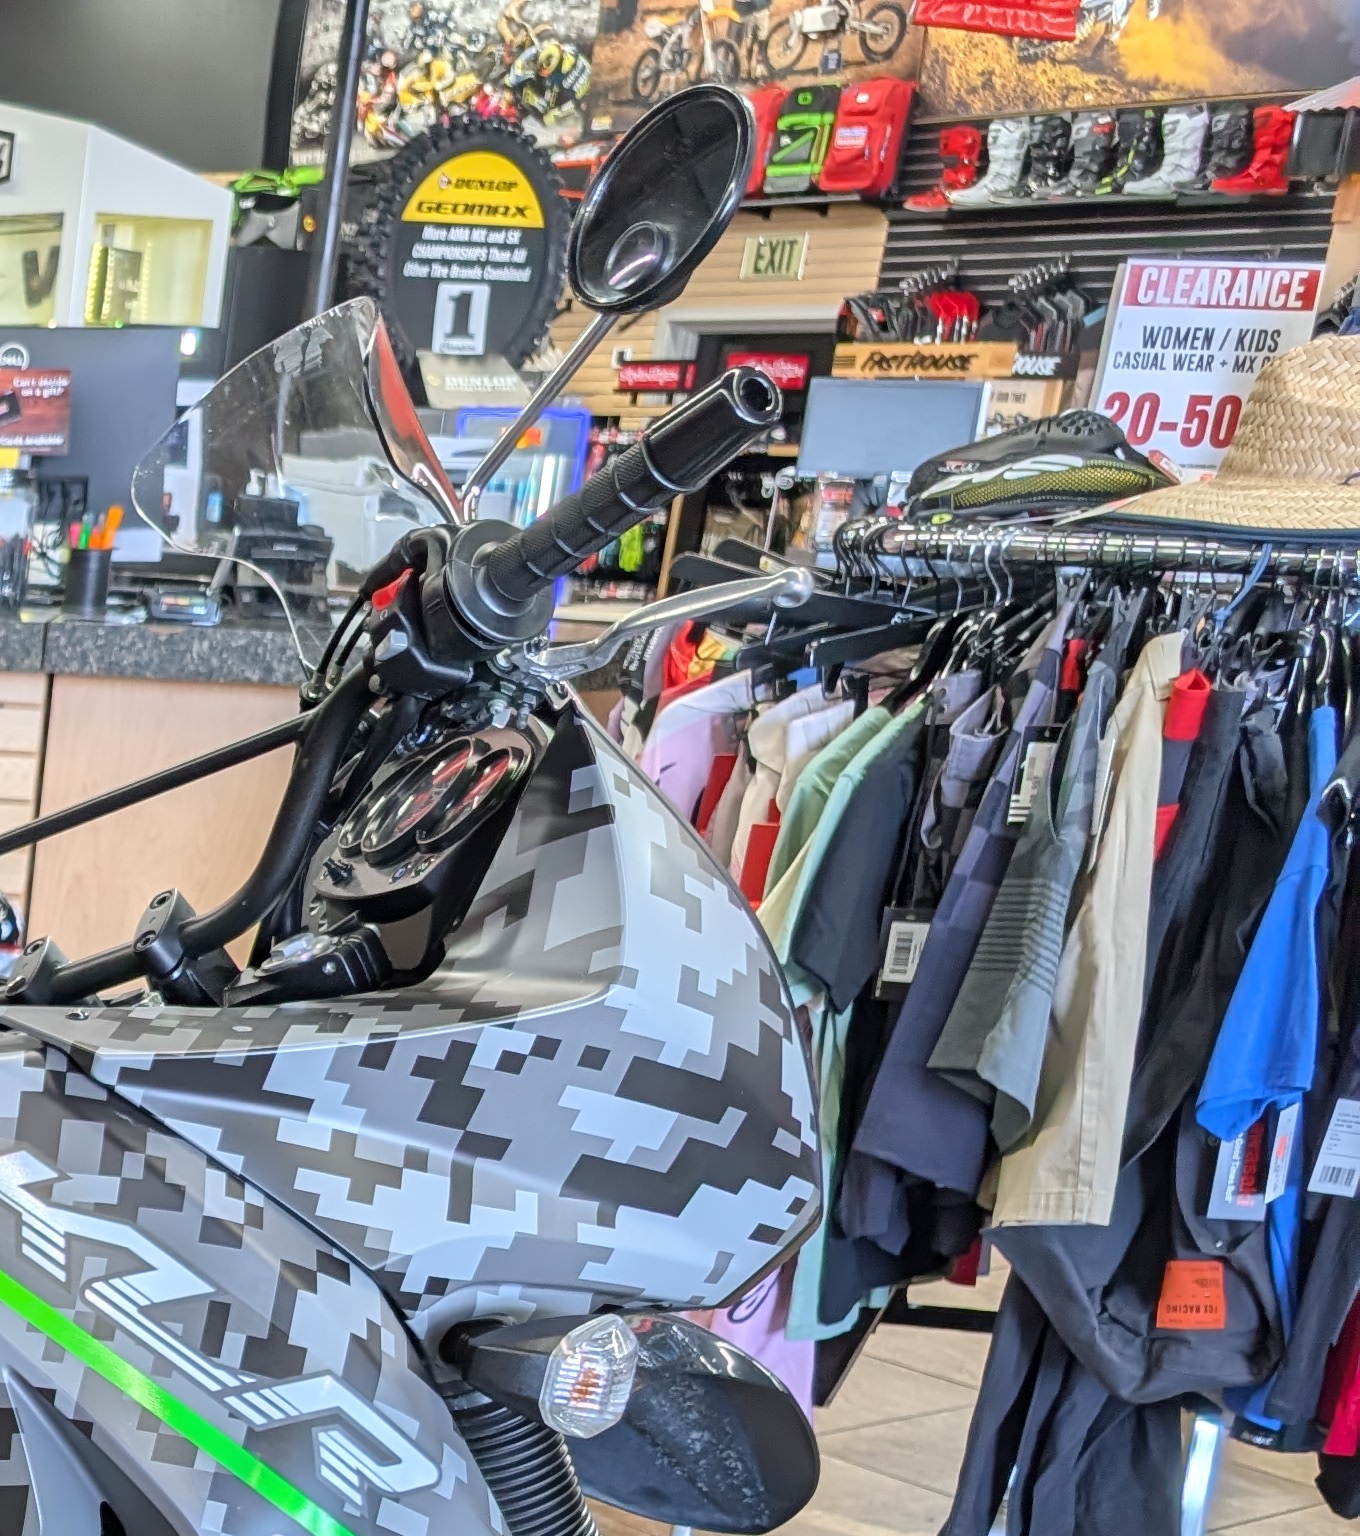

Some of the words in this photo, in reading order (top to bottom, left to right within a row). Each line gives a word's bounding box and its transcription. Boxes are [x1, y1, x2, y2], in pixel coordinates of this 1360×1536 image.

[454, 178, 518, 192] DUNLOP
[416, 200, 530, 219] GEOMAX
[753, 239, 798, 275] EXIT
[1137, 266, 1310, 310] CLEARANCE
[1142, 325, 1216, 352] WOMEN
[1234, 329, 1282, 353] KIDS
[1113, 351, 1166, 371] CASUAL
[1173, 353, 1214, 372] WEAR
[1232, 355, 1255, 374] MX
[1236, 1118, 1265, 1207] awasaki
